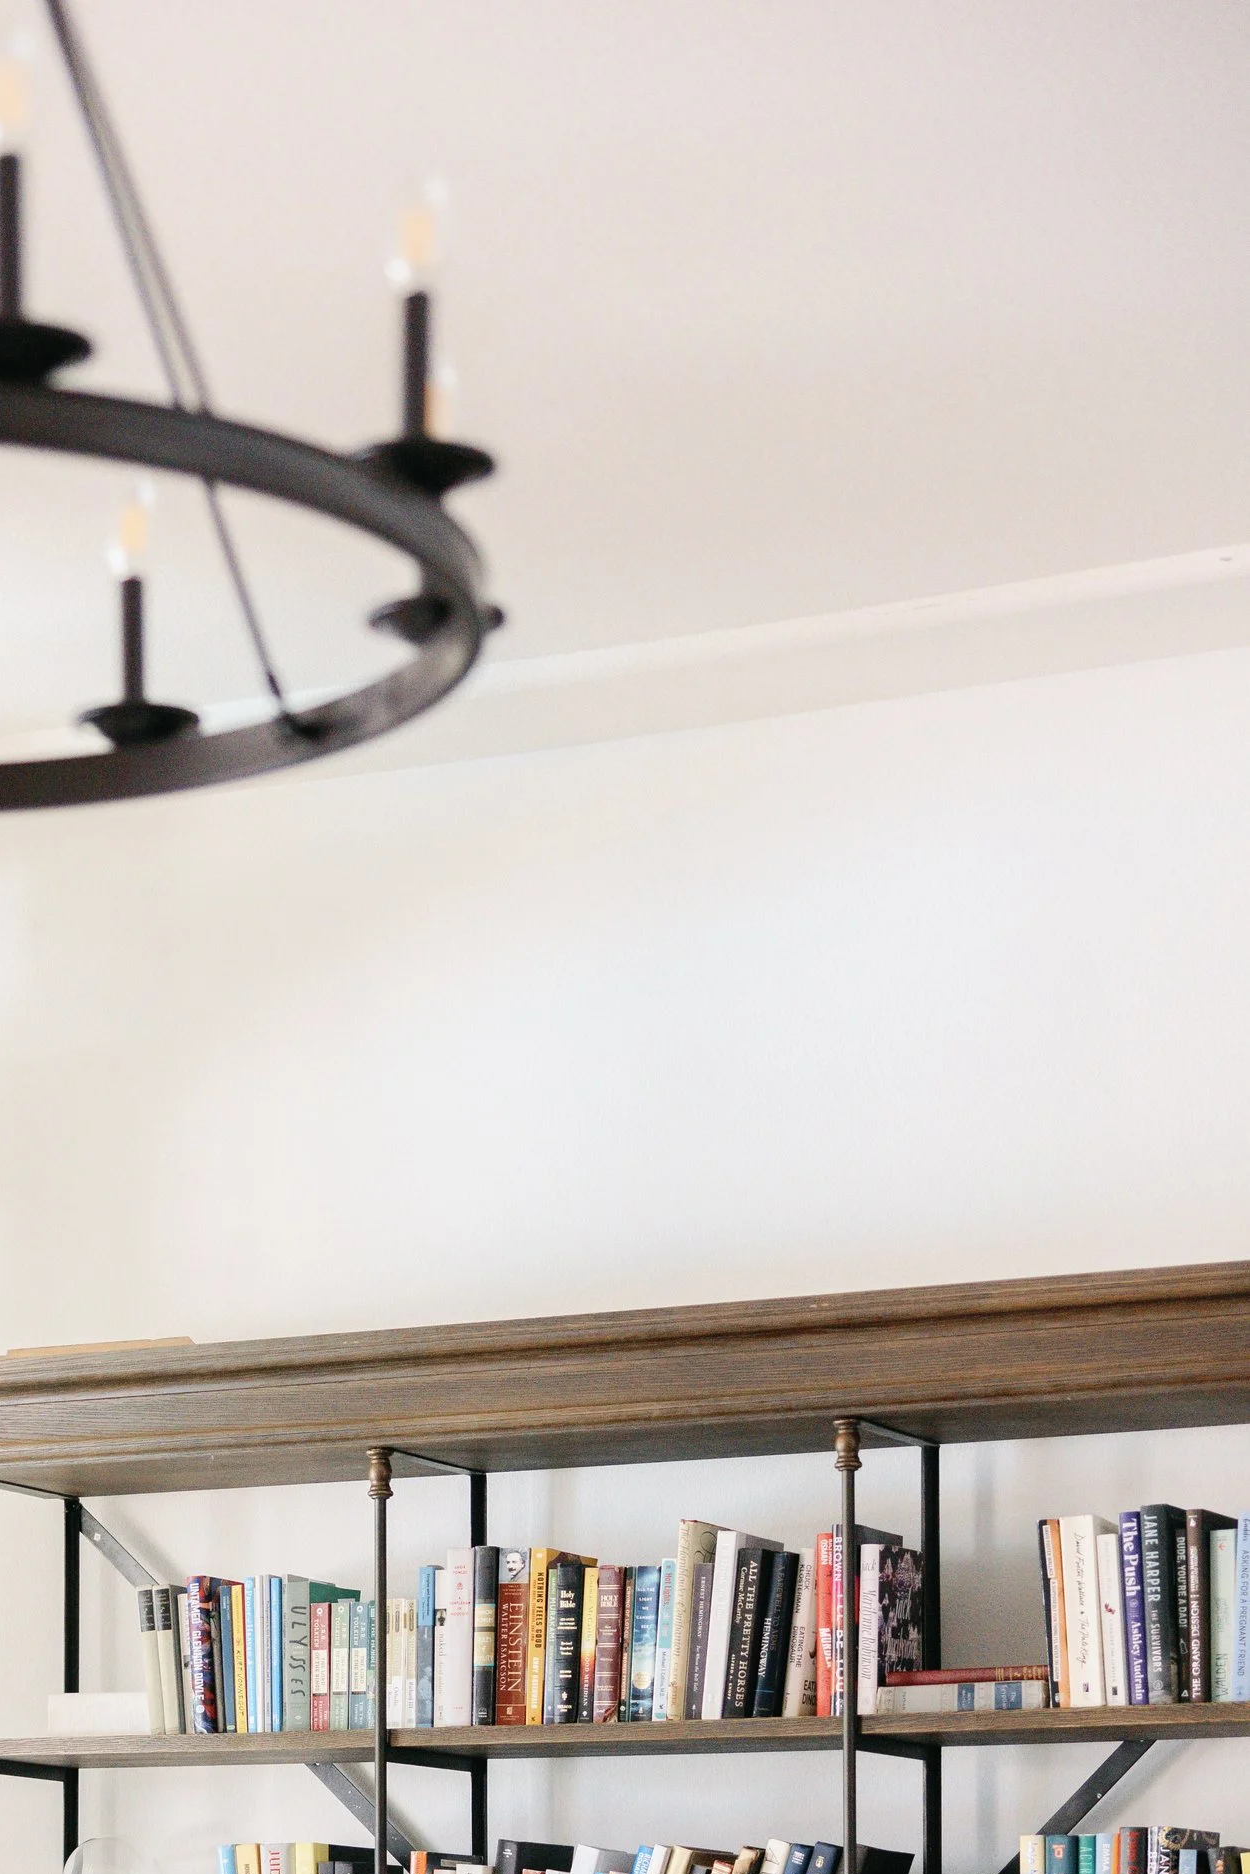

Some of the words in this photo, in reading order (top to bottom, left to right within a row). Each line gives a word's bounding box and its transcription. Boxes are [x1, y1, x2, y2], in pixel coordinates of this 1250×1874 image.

[1122, 1519, 1137, 1552] The
[1143, 1514, 1158, 1545] JANE
[820, 1539, 828, 1565] OSMAN
[834, 1537, 842, 1581] BROWN
[1176, 1537, 1186, 1563] DUDE,
[1240, 1550, 1248, 1578] ASKING
[739, 1567, 747, 1595] Cormac
[749, 1561, 757, 1581] ALL
[804, 1565, 812, 1590] CHUCK
[1124, 1554, 1140, 1597] Push
[1145, 1551, 1161, 1602] HARPER
[1177, 1565, 1187, 1597] YOU'RE
[190, 1583, 200, 1624] UNTAMED
[560, 1590, 574, 1598] Holy
[560, 1600, 576, 1608] Bible
[746, 1586, 756, 1609] THE
[795, 1564, 805, 1613] KLOSTERMAN
[1240, 1581, 1248, 1597] FOR
[735, 1597, 745, 1624] McCarthy
[862, 1590, 877, 1635] Marilynne
[1178, 1606, 1187, 1628] DAD!
[1191, 1600, 1200, 1636] DESIGN
[1238, 1606, 1248, 1646] PREGNANT
[192, 1630, 203, 1670] GLENNON
[289, 1606, 307, 1696] ULYSSES
[507, 1603, 524, 1693] EINSTEIN
[535, 1629, 543, 1648] GOOD
[742, 1614, 754, 1656] PRETTY
[758, 1618, 771, 1677] HEMINGWAY
[790, 1626, 798, 1663] DINOSAUR
[796, 1626, 805, 1652] EATING
[1131, 1621, 1142, 1656] Ashley
[861, 1637, 876, 1679] Robinson
[1192, 1640, 1200, 1674] GRAND
[1237, 1649, 1247, 1676] FRIEND
[194, 1673, 204, 1701] DOYLE
[736, 1661, 746, 1707] HORSES
[1134, 1658, 1144, 1700] Audrain
[1193, 1678, 1201, 1698] THE
[1215, 1653, 1228, 1698] WALDEN
[1102, 1843, 1110, 1872] EMMA
